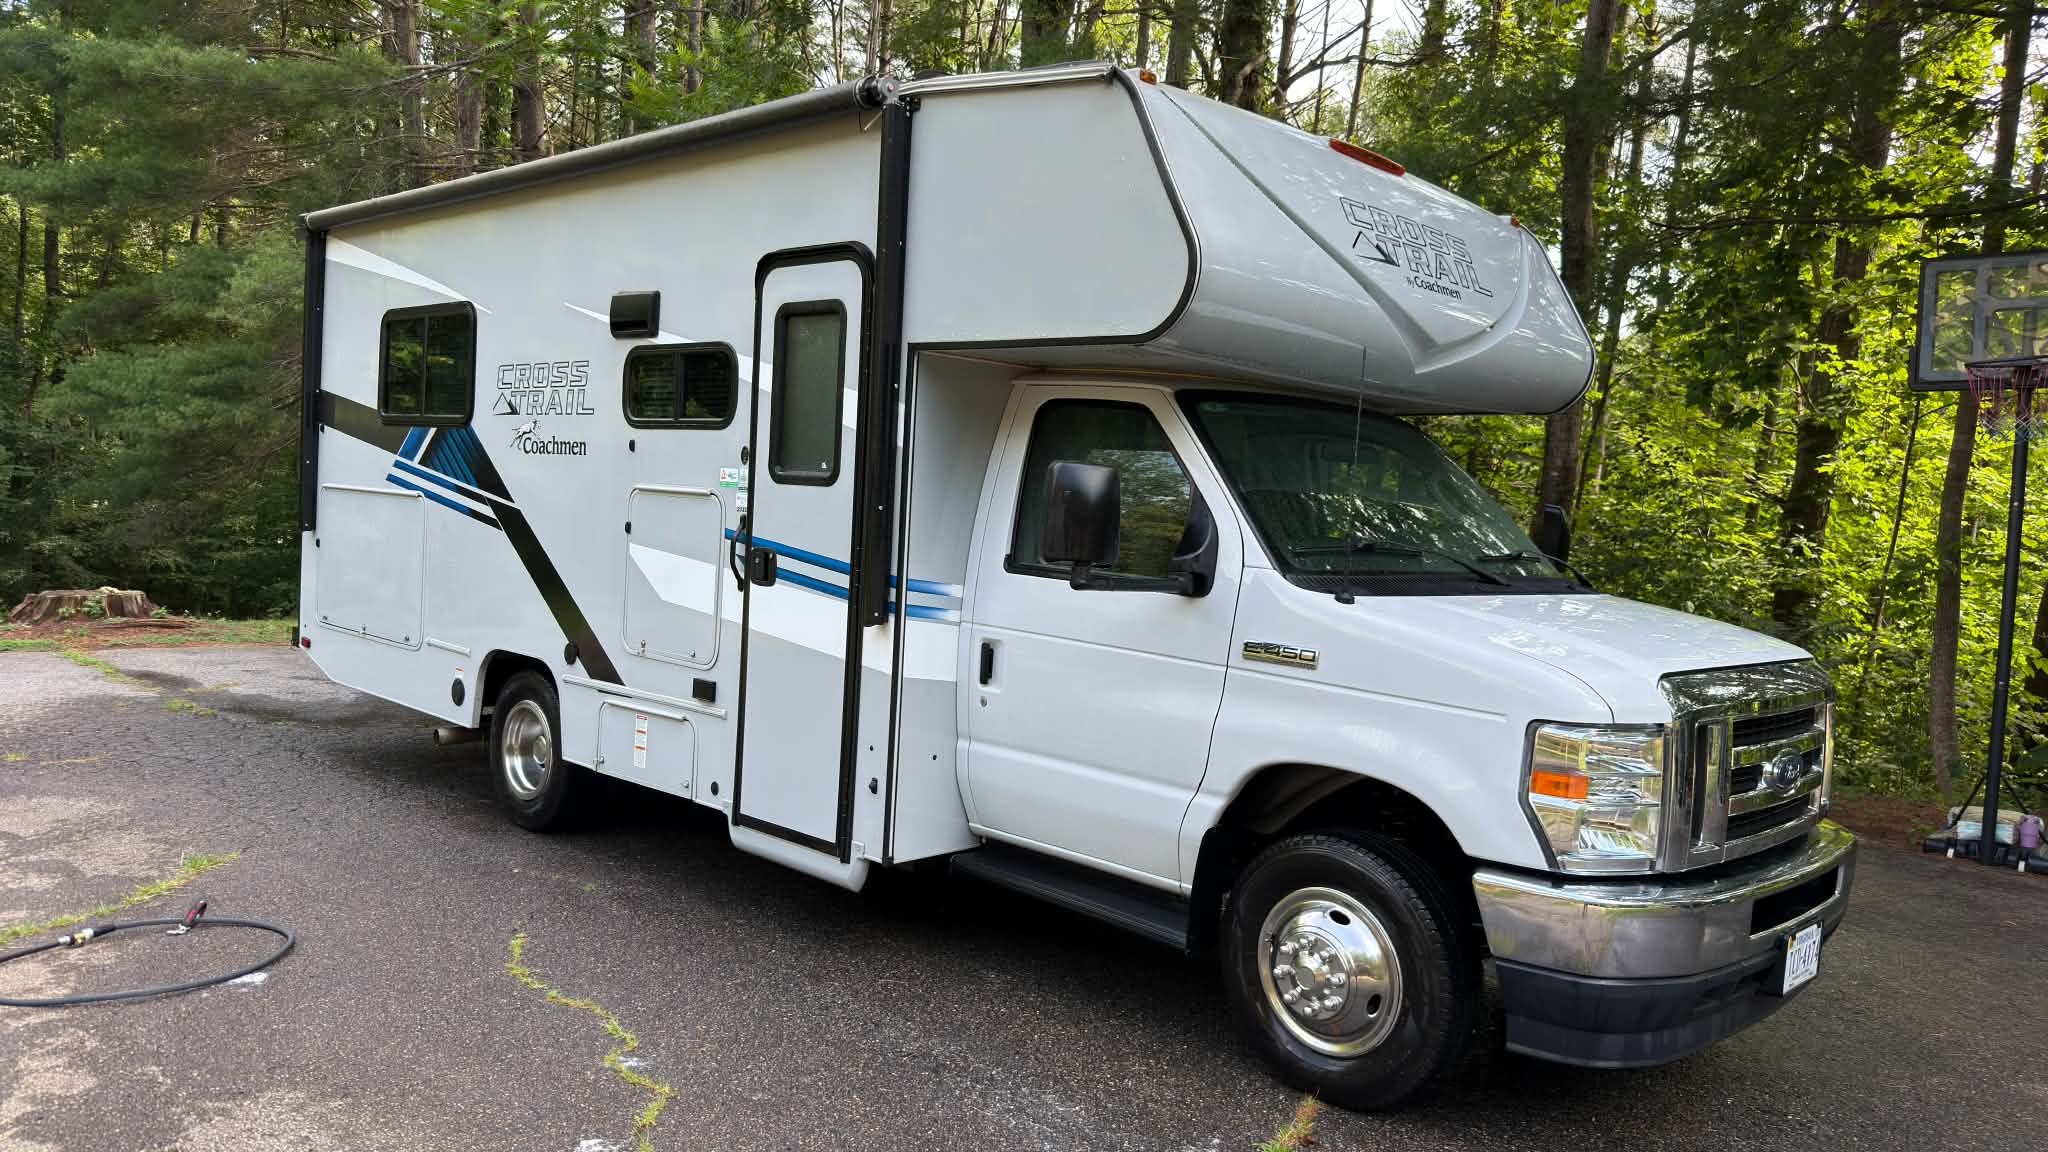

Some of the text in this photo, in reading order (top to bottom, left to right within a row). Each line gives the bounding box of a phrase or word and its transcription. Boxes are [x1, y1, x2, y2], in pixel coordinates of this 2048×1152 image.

[1339, 196, 1473, 265] CROSS
[1375, 233, 1494, 298] TRAIL
[1414, 275, 1462, 301] Coachmen
[497, 360, 590, 390] CROSS
[511, 388, 595, 416] TRAIL
[523, 435, 587, 456] Coachmen
